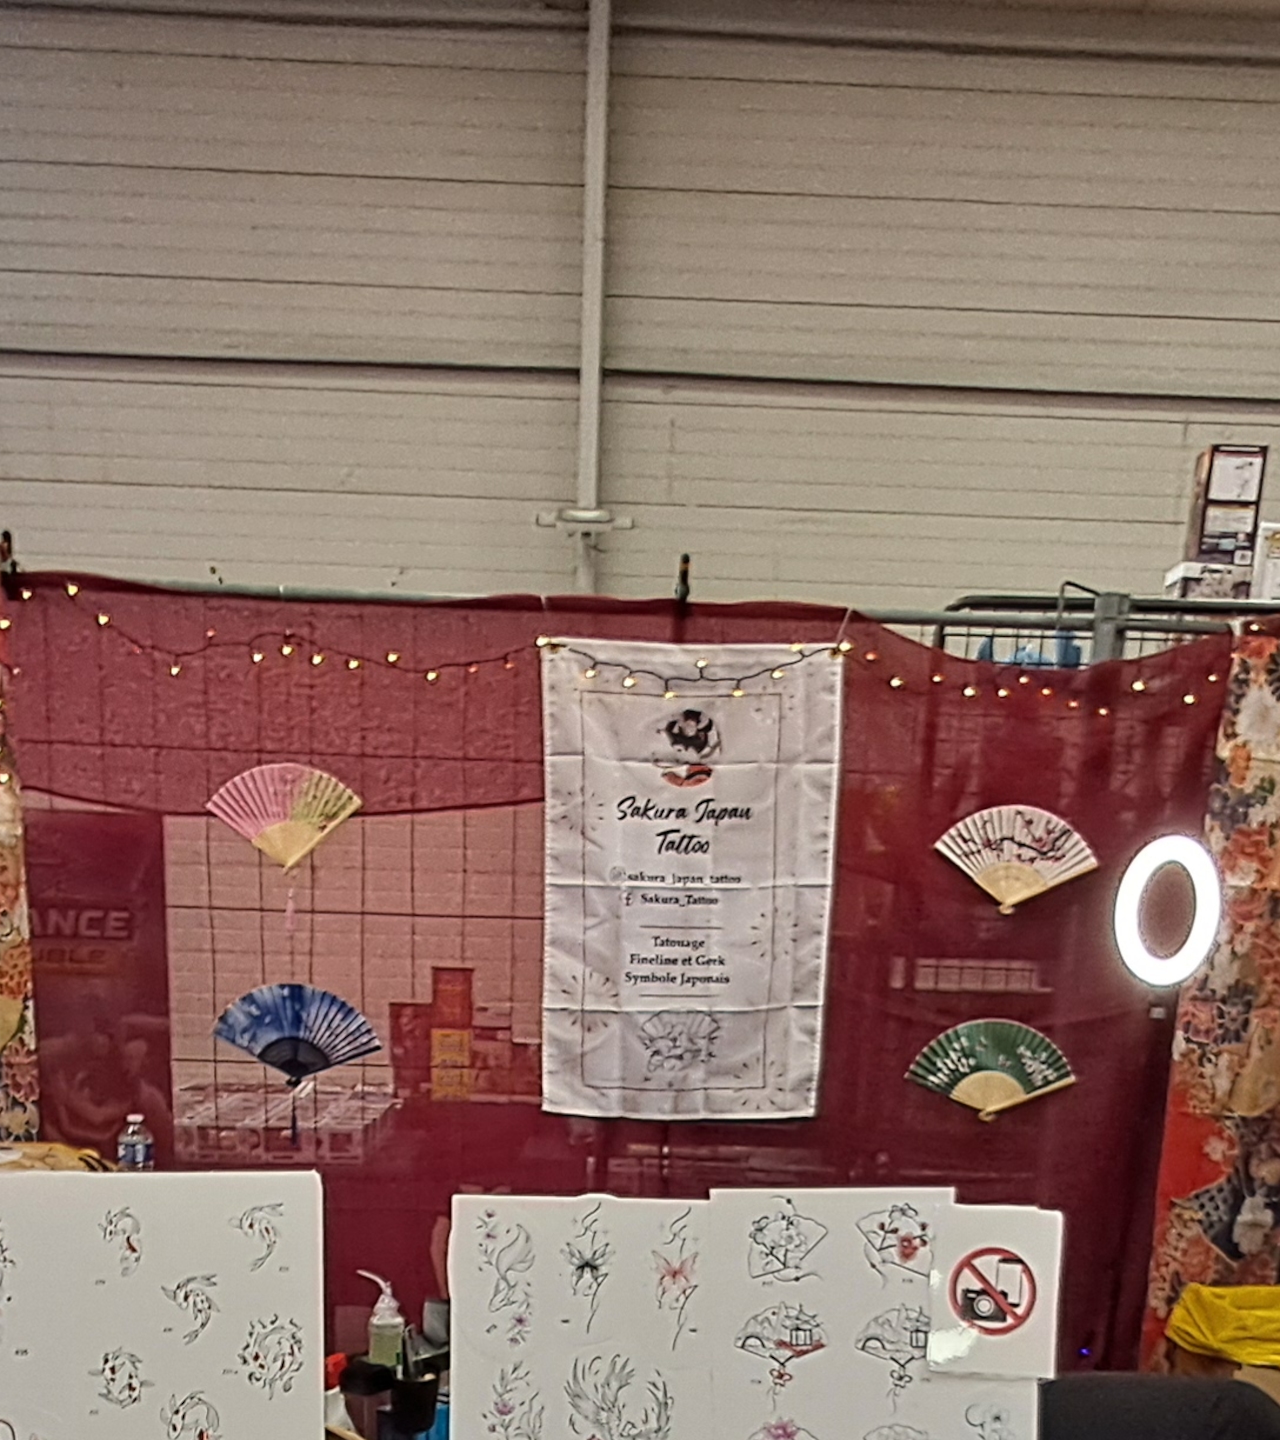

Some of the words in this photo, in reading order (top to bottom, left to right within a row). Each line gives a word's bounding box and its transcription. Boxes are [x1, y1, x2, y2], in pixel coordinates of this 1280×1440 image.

[616, 797, 688, 821] Sakura
[695, 798, 754, 825] Japan
[655, 829, 711, 855] Tattoo
[652, 936, 705, 951] Tatouage
[630, 953, 678, 966] Fineline
[681, 956, 692, 966] et
[624, 972, 677, 985] Symbole
[680, 972, 730, 987] Japonais
